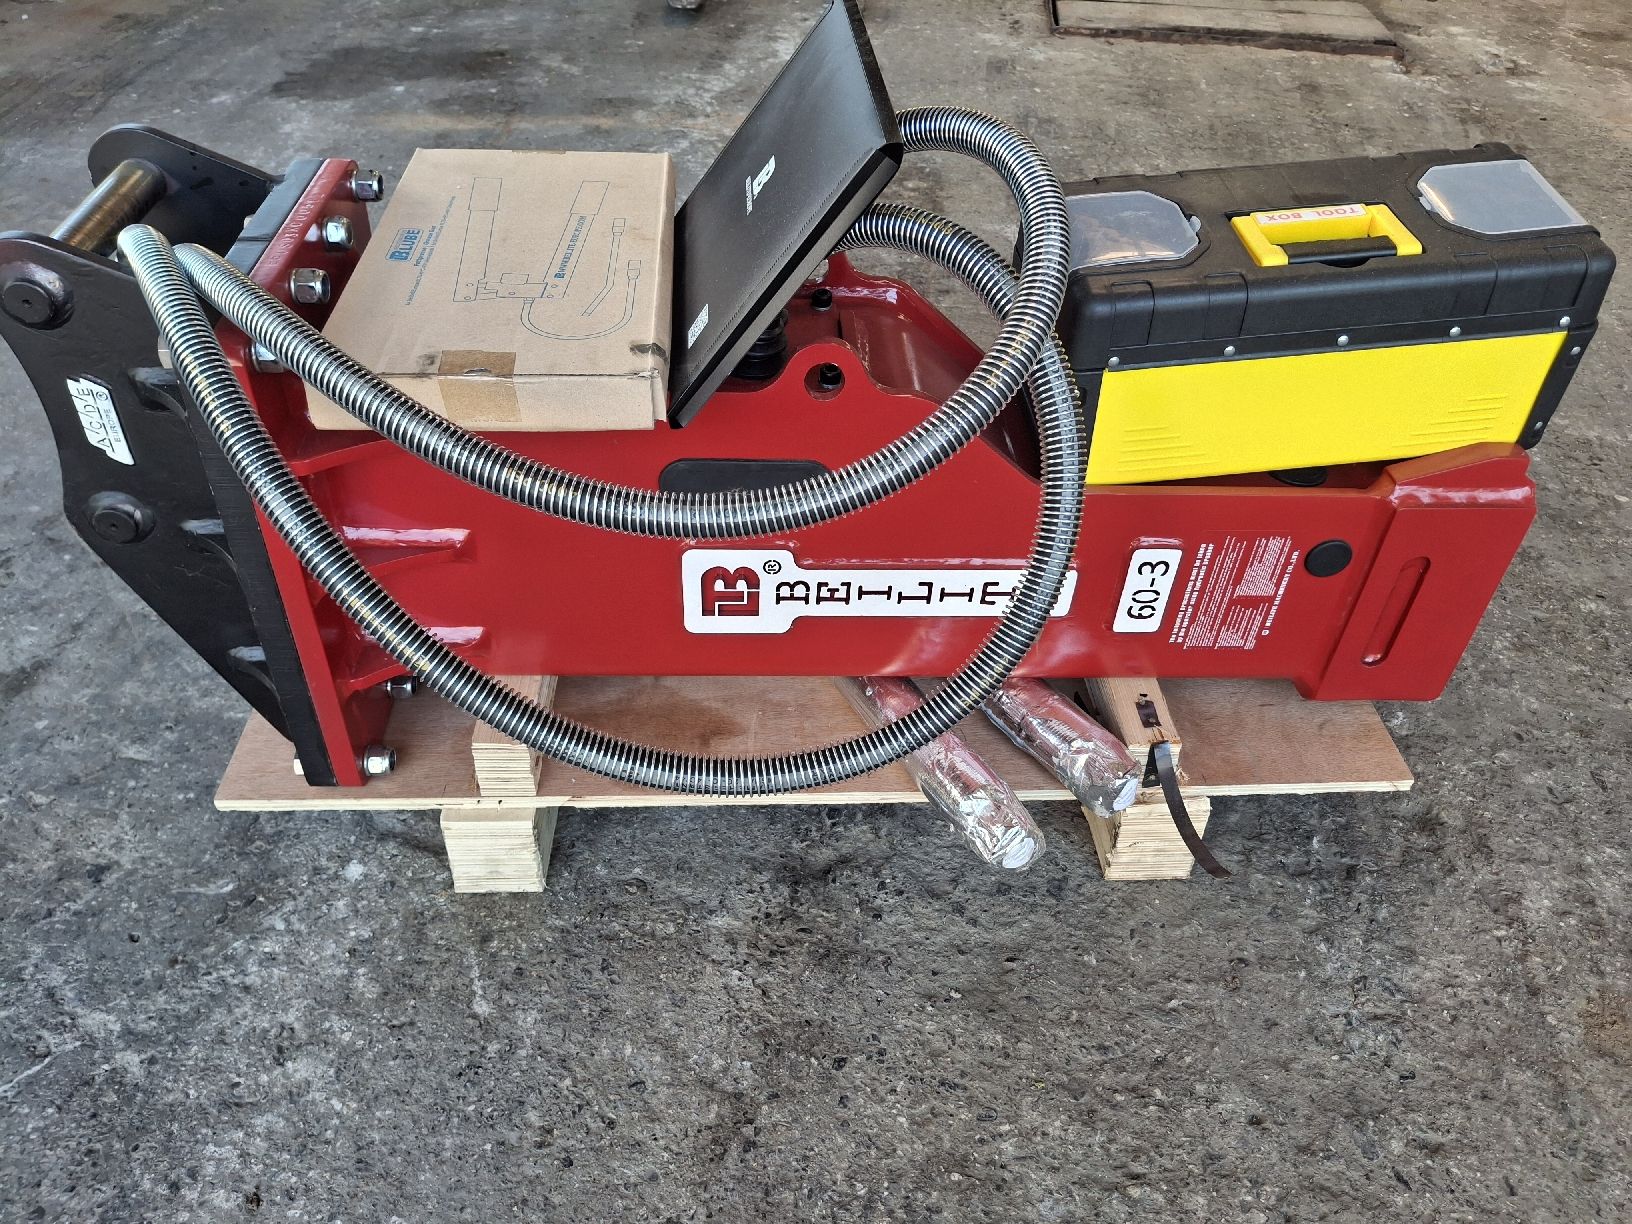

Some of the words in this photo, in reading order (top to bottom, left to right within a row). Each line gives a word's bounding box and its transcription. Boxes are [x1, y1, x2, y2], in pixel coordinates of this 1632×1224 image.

[1265, 212, 1303, 222] BOX
[1316, 207, 1360, 217] TOOL
[104, 408, 122, 443] EUROPE
[775, 580, 1019, 606] BEILIT
[1126, 560, 1170, 620] 60-3
